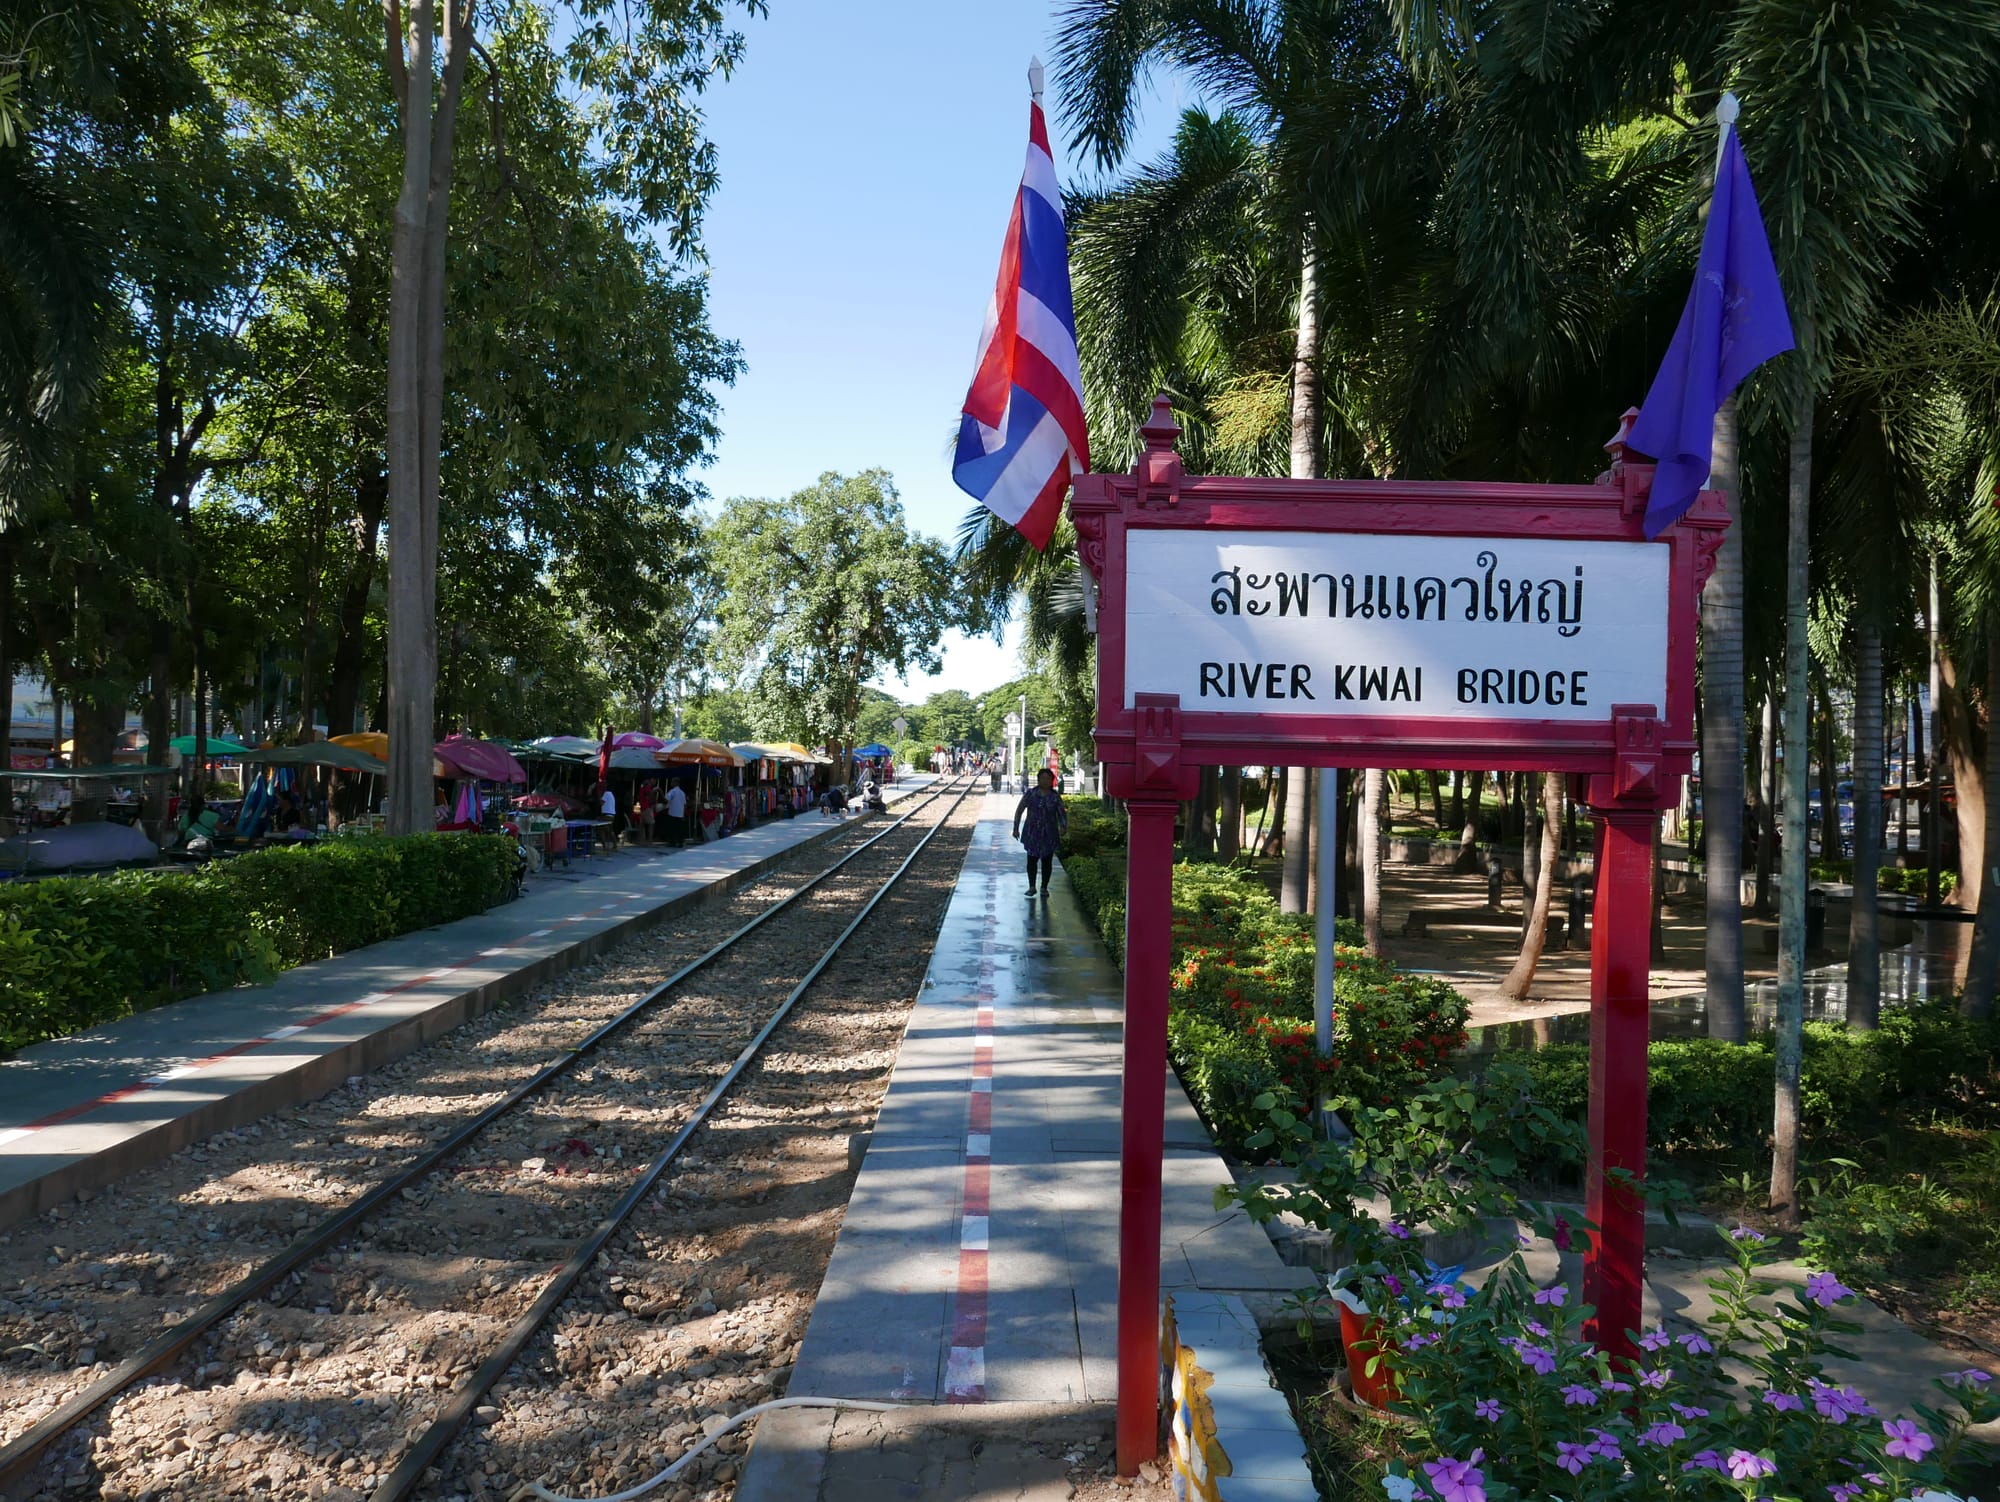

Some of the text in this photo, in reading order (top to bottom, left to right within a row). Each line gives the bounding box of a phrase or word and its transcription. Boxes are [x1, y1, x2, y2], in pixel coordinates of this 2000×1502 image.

[1211, 551, 1583, 637] สะพานแควใหญ่
[1200, 663, 1589, 707] RIVER KWAI BRIDGE
